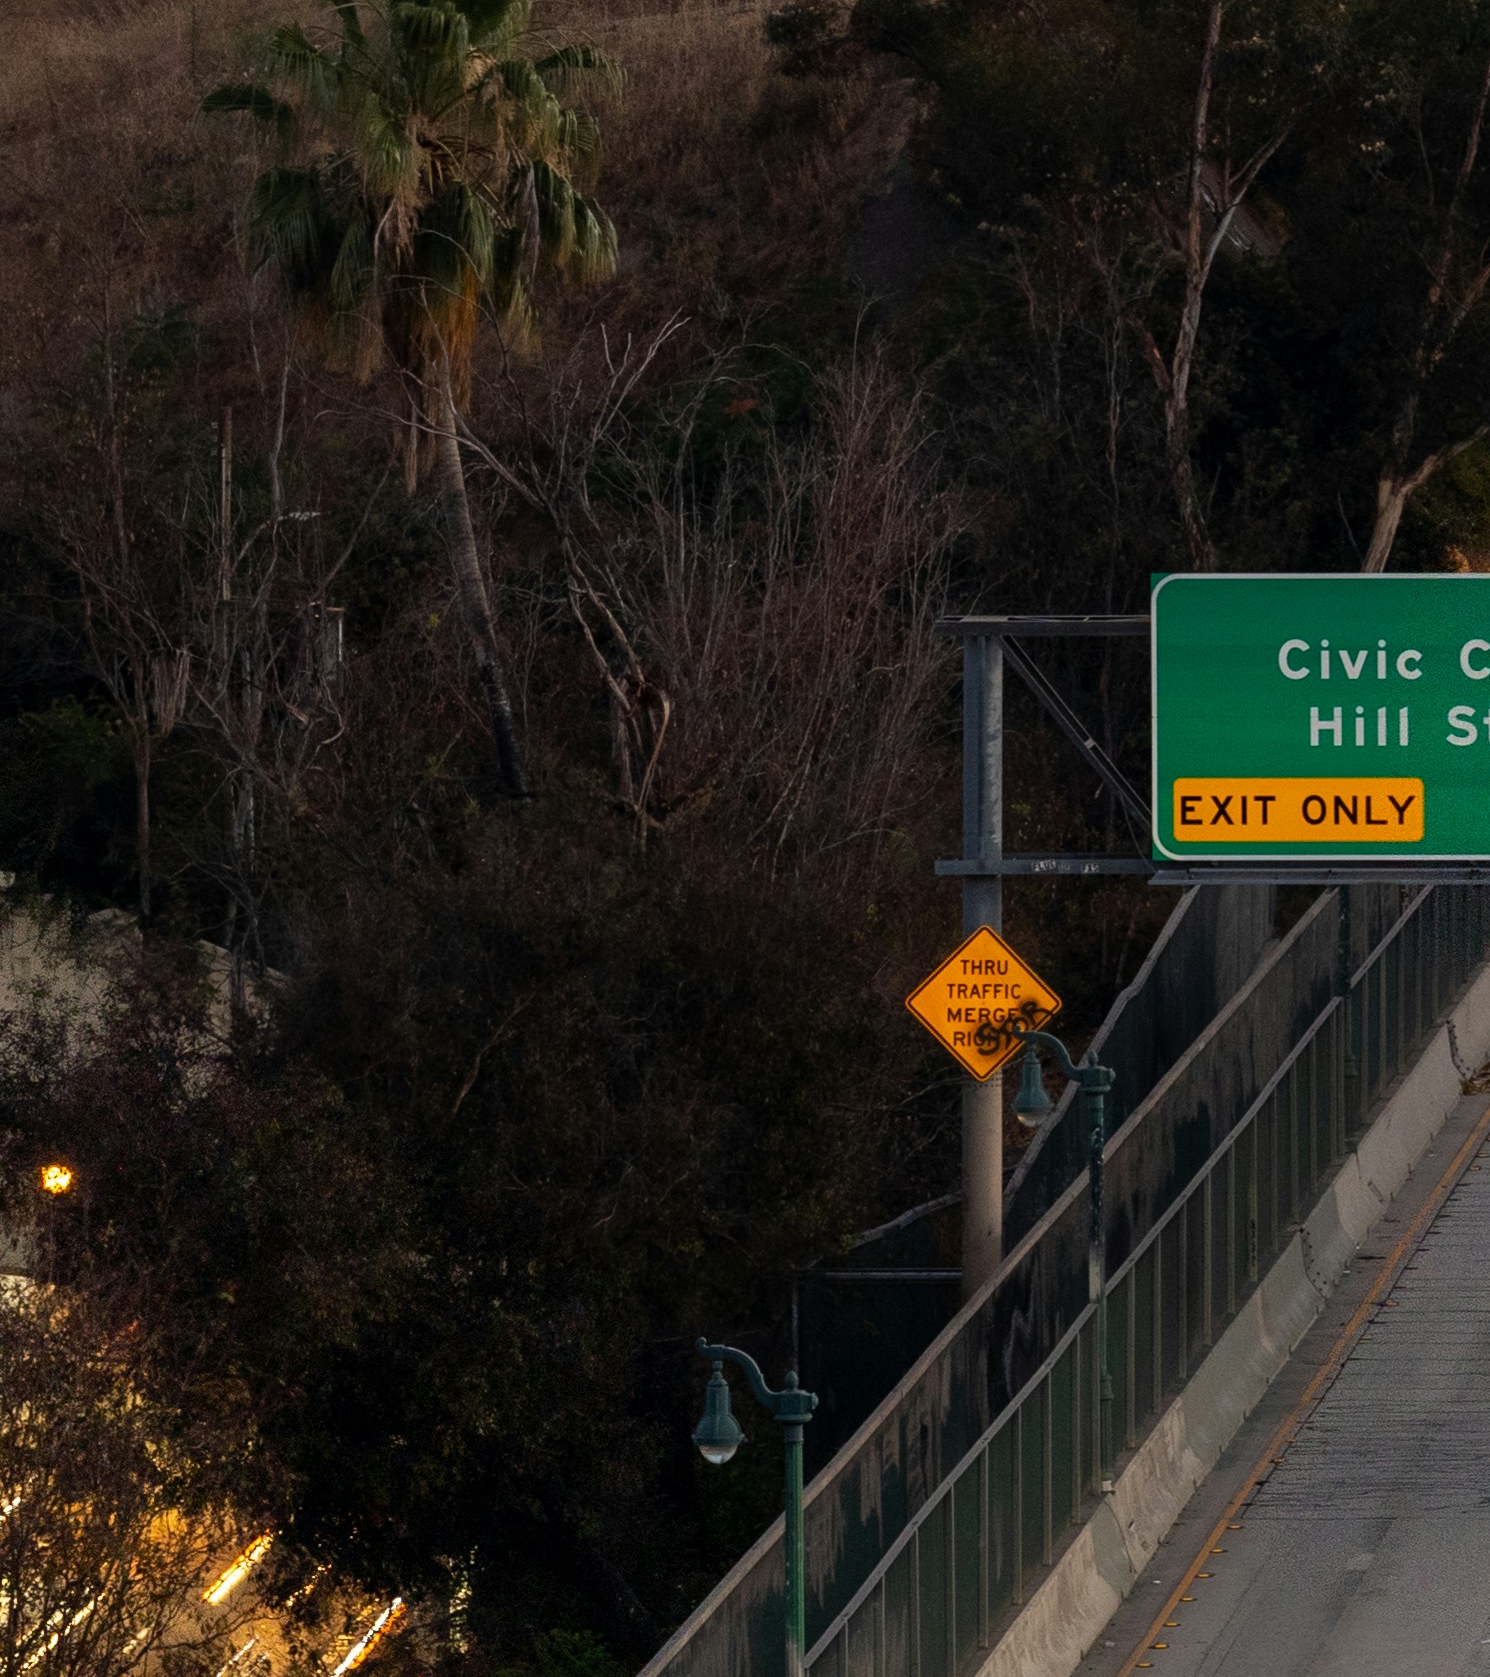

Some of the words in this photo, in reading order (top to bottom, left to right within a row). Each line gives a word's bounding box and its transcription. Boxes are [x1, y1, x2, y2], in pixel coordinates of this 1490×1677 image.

[1278, 638, 1423, 680] Civic
[1310, 705, 1409, 747] Hill
[1180, 795, 1276, 826] EXIT
[1301, 794, 1415, 826] ONLY
[960, 960, 1008, 975] THRU
[947, 984, 1021, 999] TRAFFIC
[947, 1008, 1019, 1023] MERGE
[954, 1031, 1014, 1046] RIG
